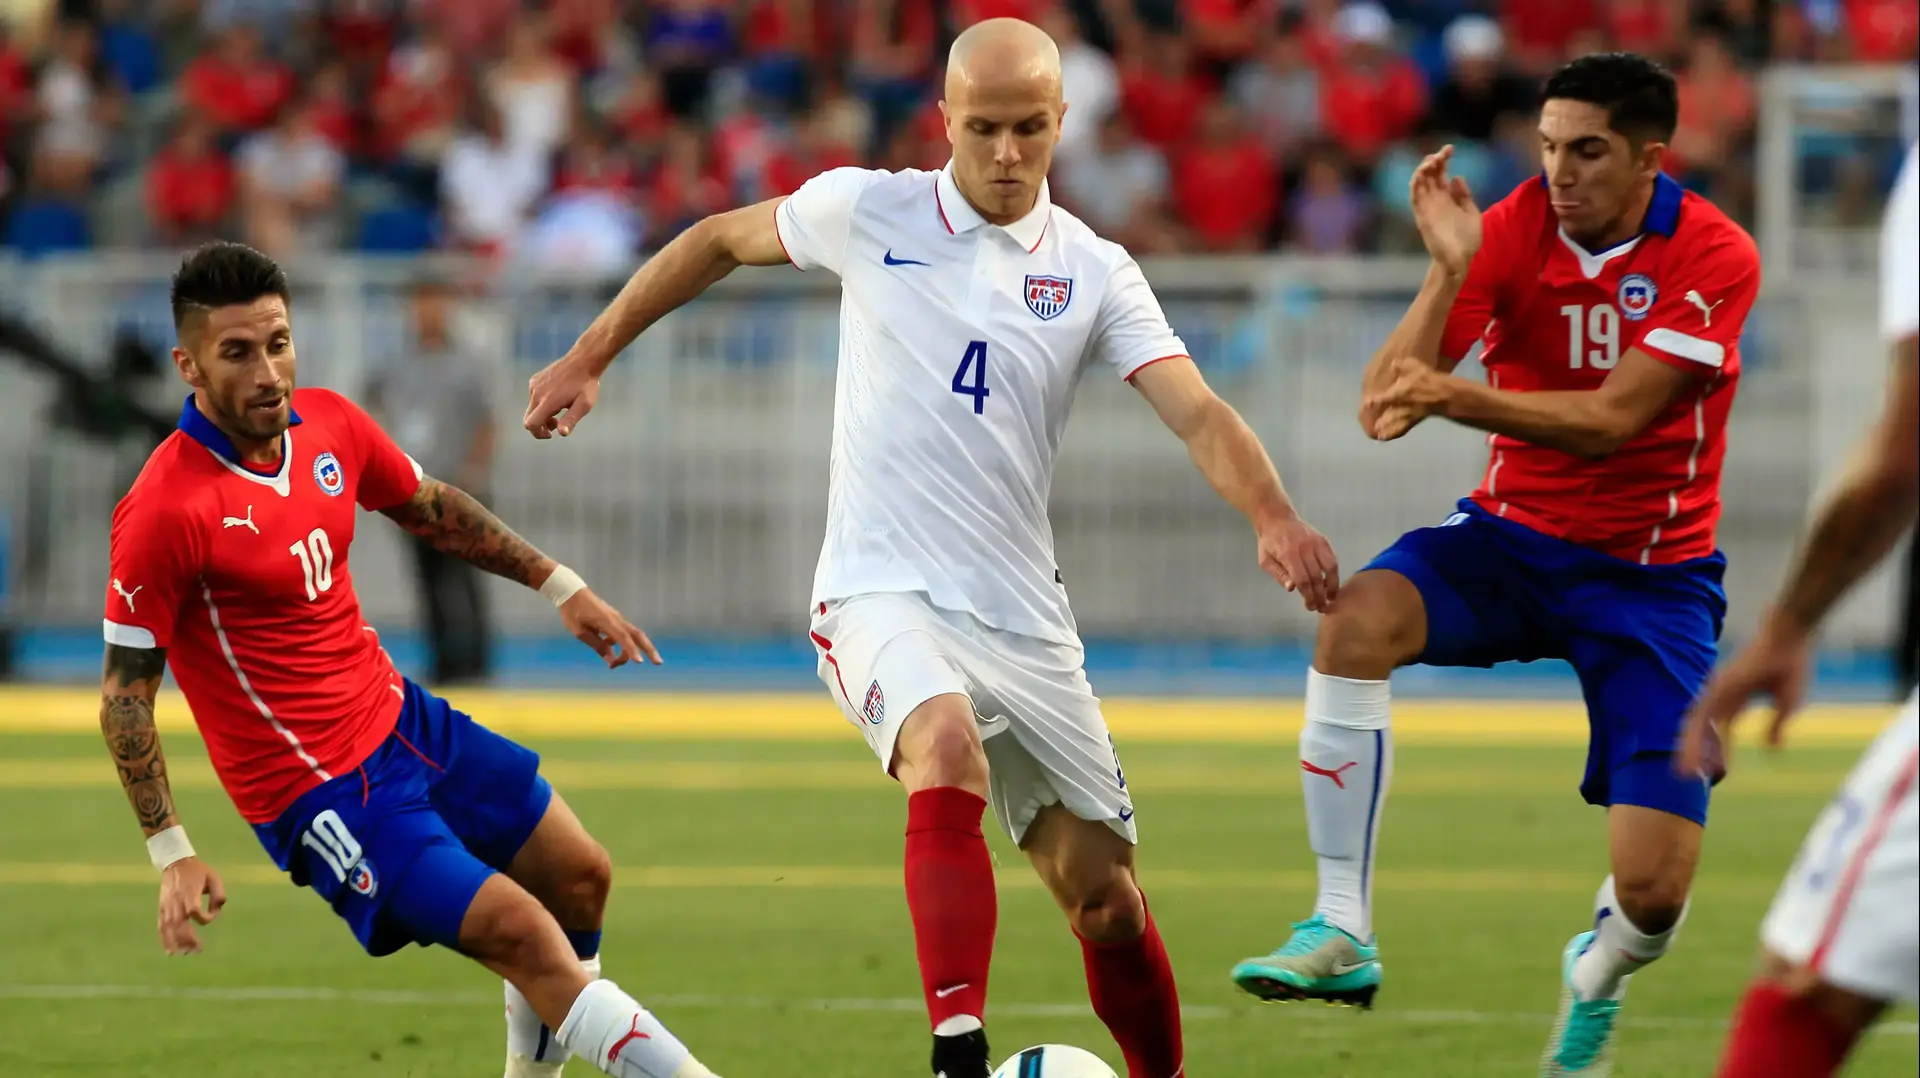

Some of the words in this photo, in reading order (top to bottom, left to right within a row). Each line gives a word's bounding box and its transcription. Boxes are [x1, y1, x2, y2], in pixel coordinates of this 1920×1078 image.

[1560, 303, 1620, 370] 19
[951, 340, 990, 415] 4
[289, 527, 333, 602] 10
[301, 808, 363, 884] 10
